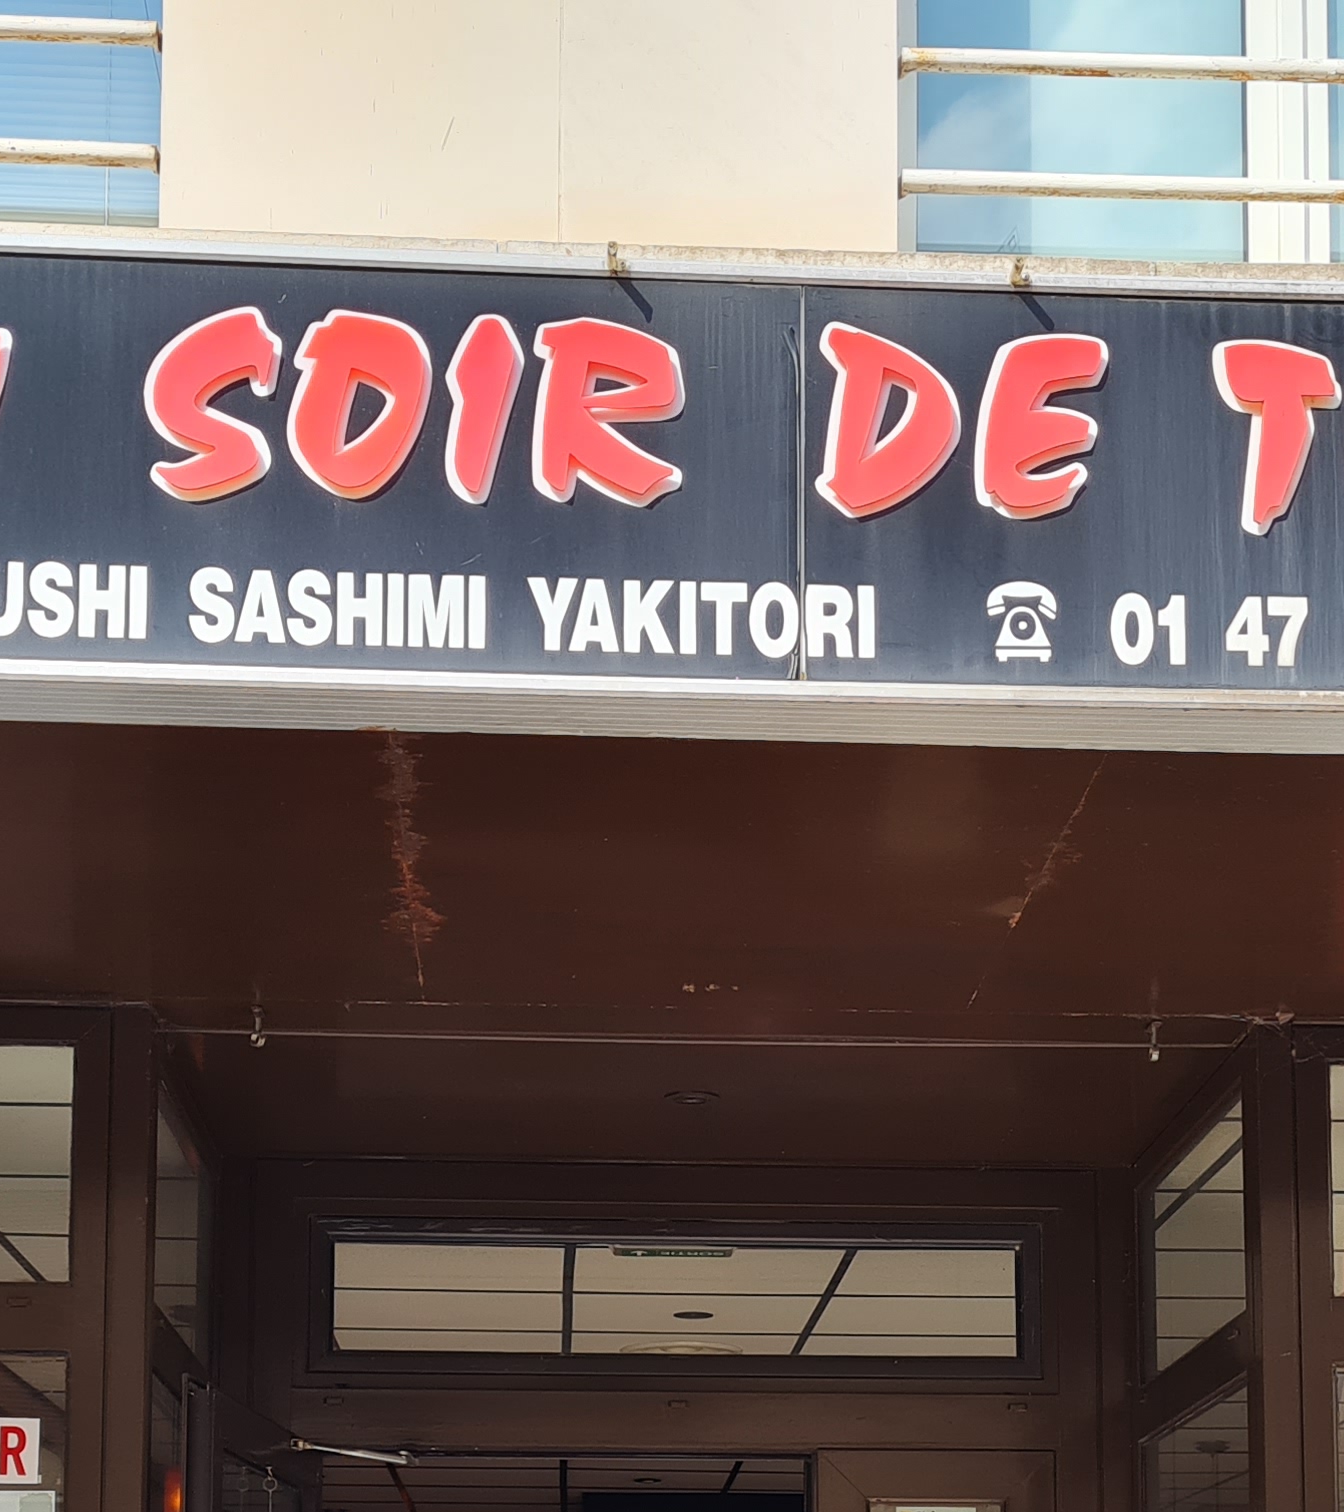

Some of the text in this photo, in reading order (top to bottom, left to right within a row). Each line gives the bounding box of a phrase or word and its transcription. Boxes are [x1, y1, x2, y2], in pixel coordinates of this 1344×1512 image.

[144, 305, 685, 508] SOIR
[815, 321, 1110, 520] DE
[189, 568, 487, 650] SASHIMI
[528, 576, 876, 659] YAKITORI
[1109, 592, 1187, 666] 01
[1225, 595, 1310, 668] 47
